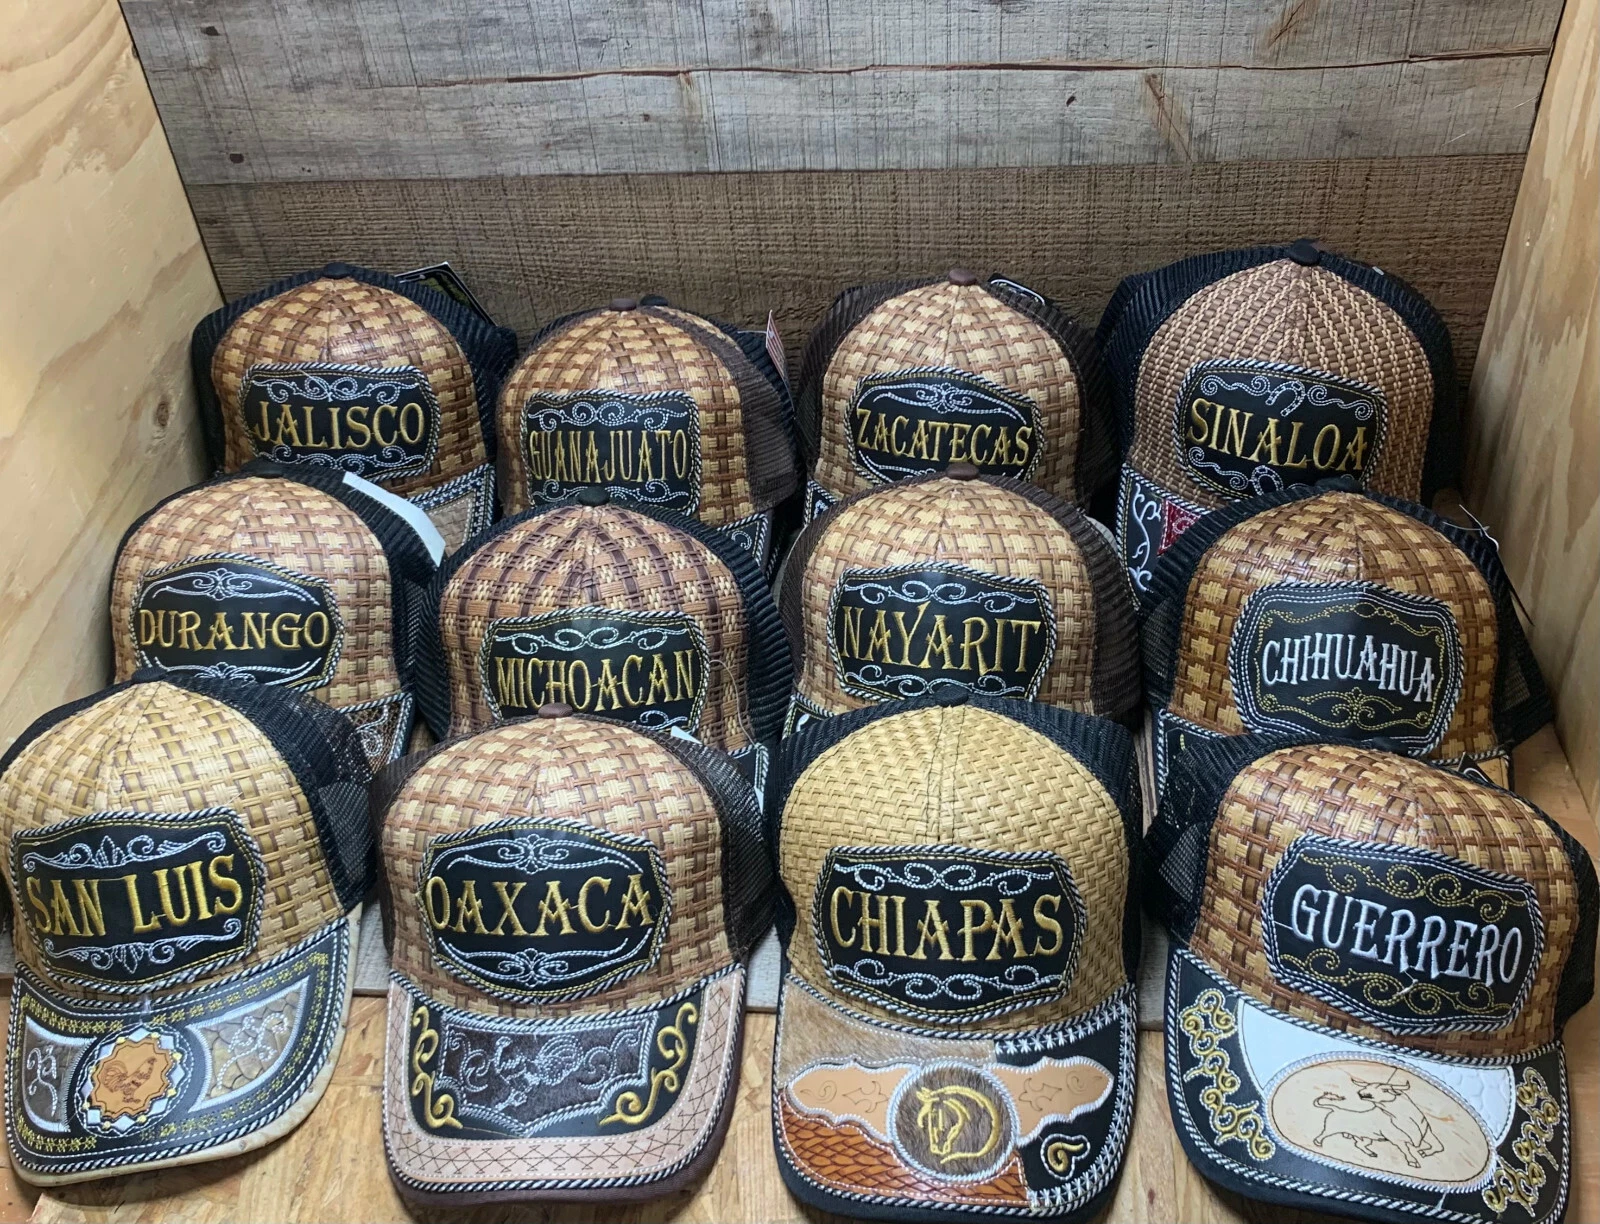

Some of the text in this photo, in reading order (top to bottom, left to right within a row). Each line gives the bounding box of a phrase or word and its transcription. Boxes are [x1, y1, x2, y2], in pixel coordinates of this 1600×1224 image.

[253, 401, 425, 450] JALISCO
[529, 429, 688, 484] GUANAJUATO
[856, 408, 1033, 466] ZACATECAS
[1190, 397, 1367, 471] SINALOA
[139, 609, 330, 652] DURANGO
[840, 603, 1041, 674] NAYARIT
[494, 649, 694, 712] MICHOACAN
[1262, 632, 1436, 700] CHIHUAHUA
[27, 855, 244, 941] SAN LUIS
[426, 873, 654, 938] OAXACA
[830, 886, 1064, 961] CHIAPAS
[1291, 884, 1522, 985] GUERRERO
